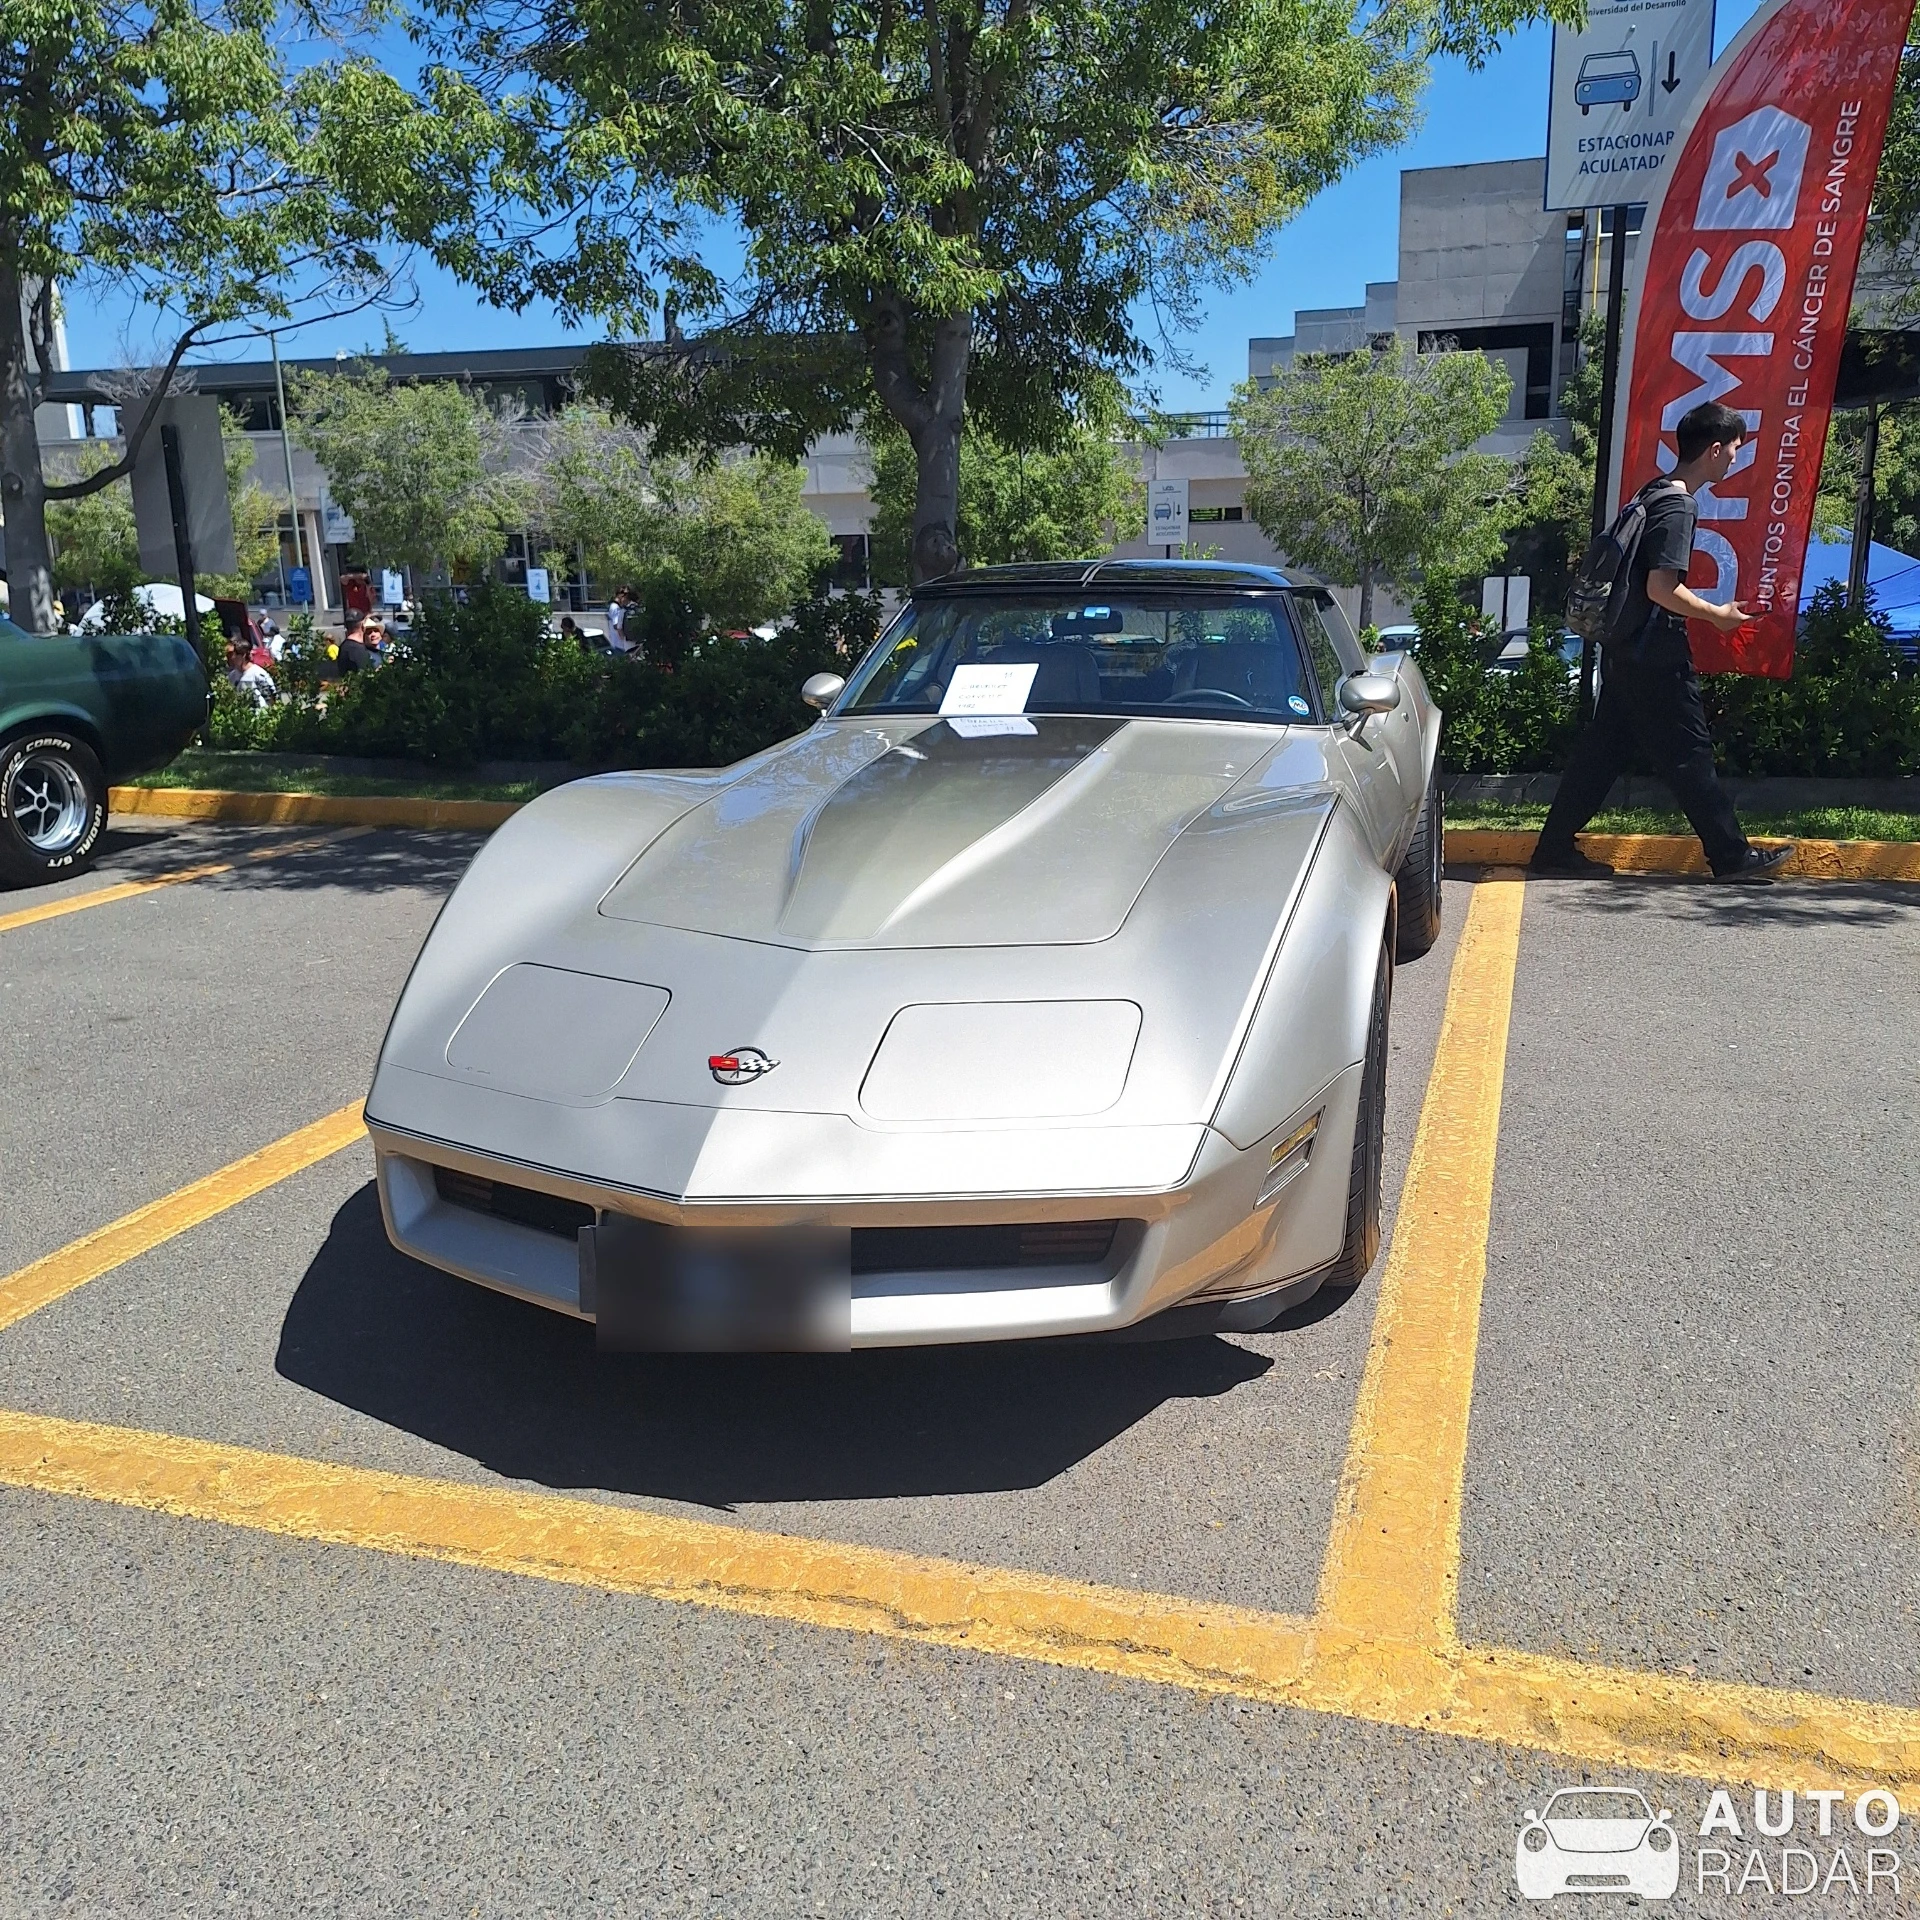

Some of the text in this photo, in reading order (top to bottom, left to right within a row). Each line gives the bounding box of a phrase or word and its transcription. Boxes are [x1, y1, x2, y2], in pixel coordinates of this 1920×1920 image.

[1585, 0, 1687, 17] niversidad del Desarrollo
[1756, 100, 1863, 612] JUNTOS CONTRA EL CÁNCER DE SANGRE
[0, 737, 72, 819] COOPER COBRA
[75, 803, 103, 855] RADIAL
